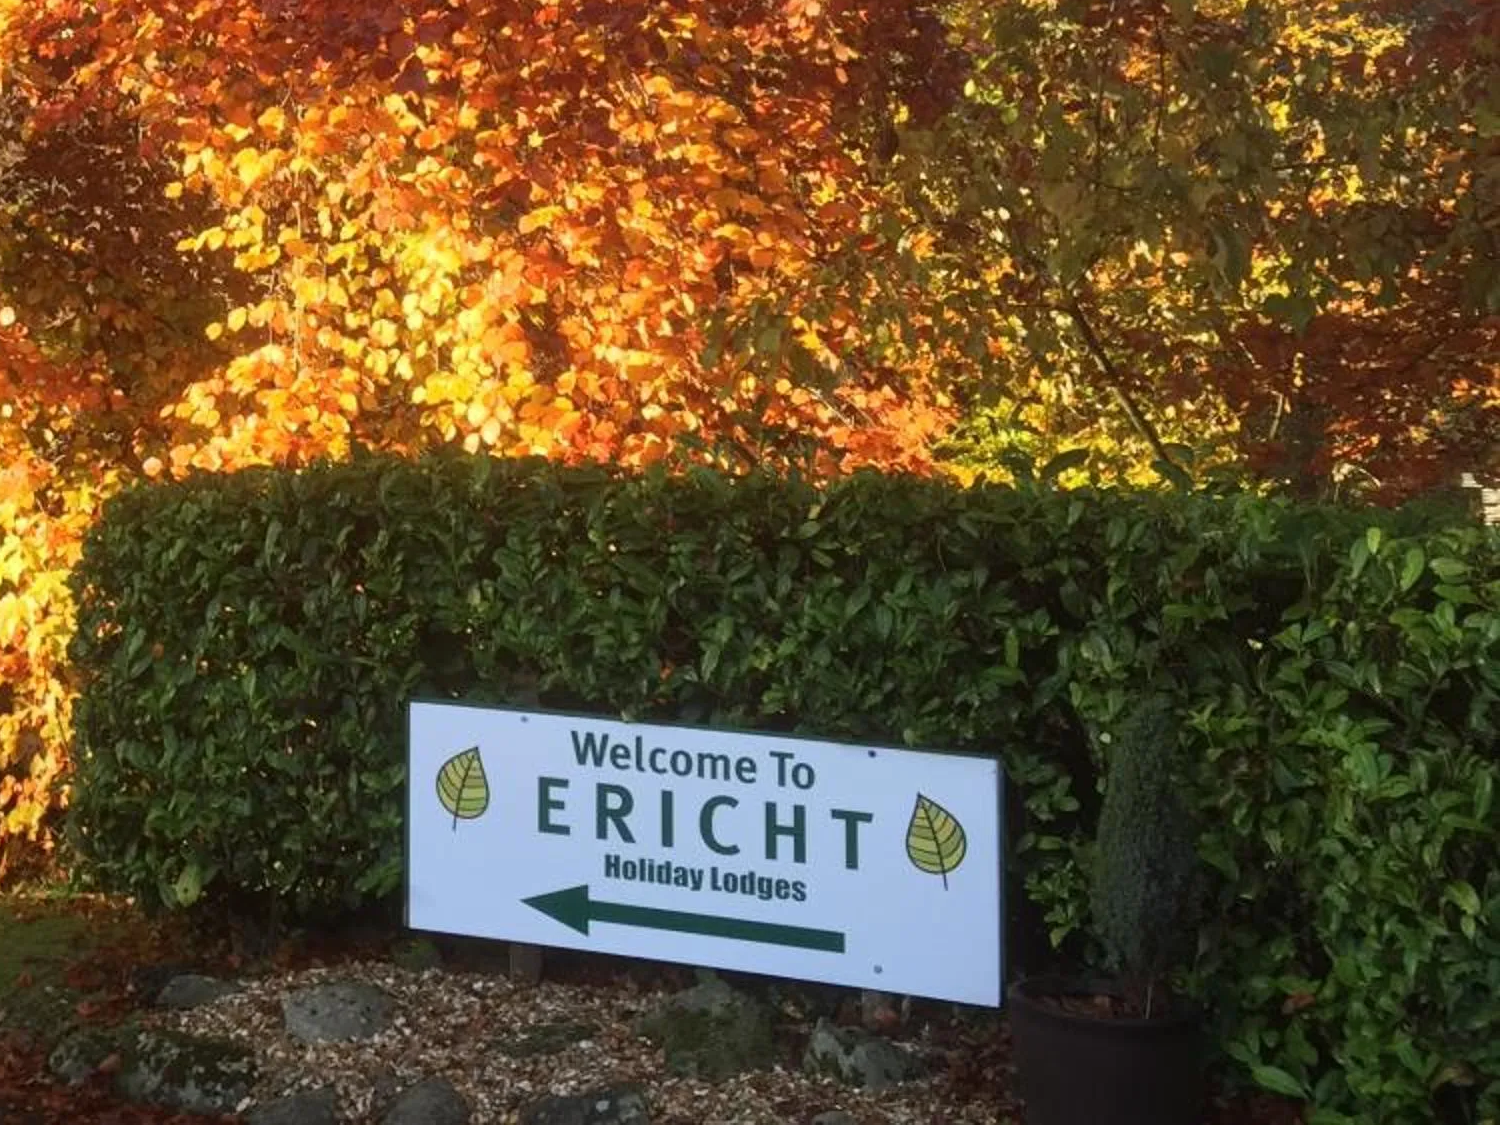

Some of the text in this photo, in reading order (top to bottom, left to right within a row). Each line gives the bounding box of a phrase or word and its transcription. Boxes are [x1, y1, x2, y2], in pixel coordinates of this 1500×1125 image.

[570, 730, 815, 790] Welcome To
[537, 776, 873, 870] ERICHT
[604, 853, 807, 902] Holiday Lodges
